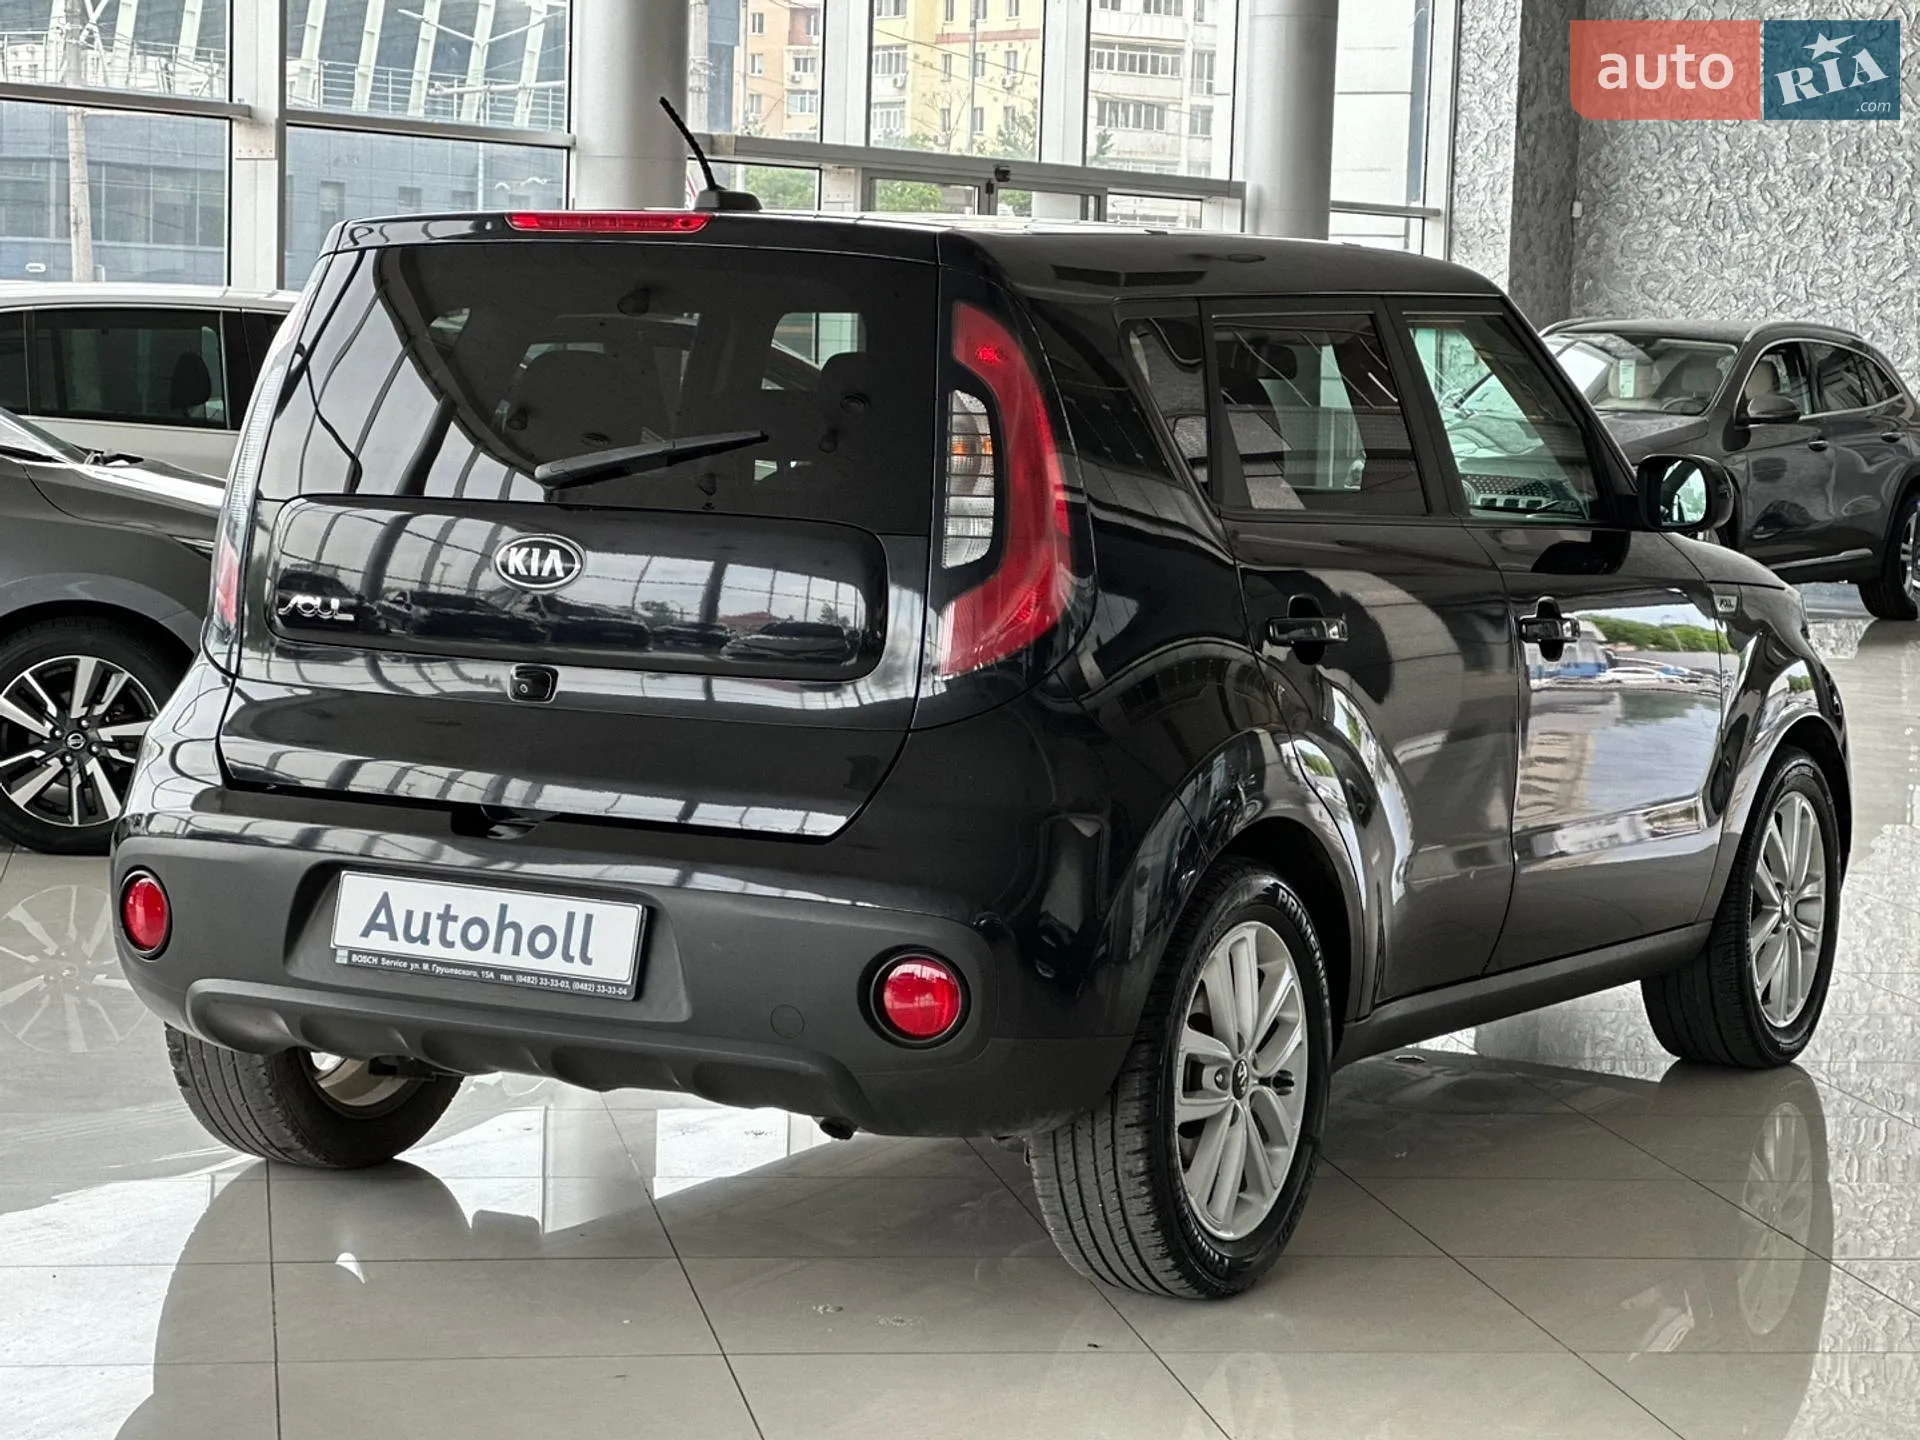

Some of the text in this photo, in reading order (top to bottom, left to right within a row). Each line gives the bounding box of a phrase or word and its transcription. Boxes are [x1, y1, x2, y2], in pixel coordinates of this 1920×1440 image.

[507, 546, 565, 578] KIA
[359, 891, 594, 966] Autoholl
[351, 954, 378, 965] BOSCH
[381, 957, 408, 968] Service
